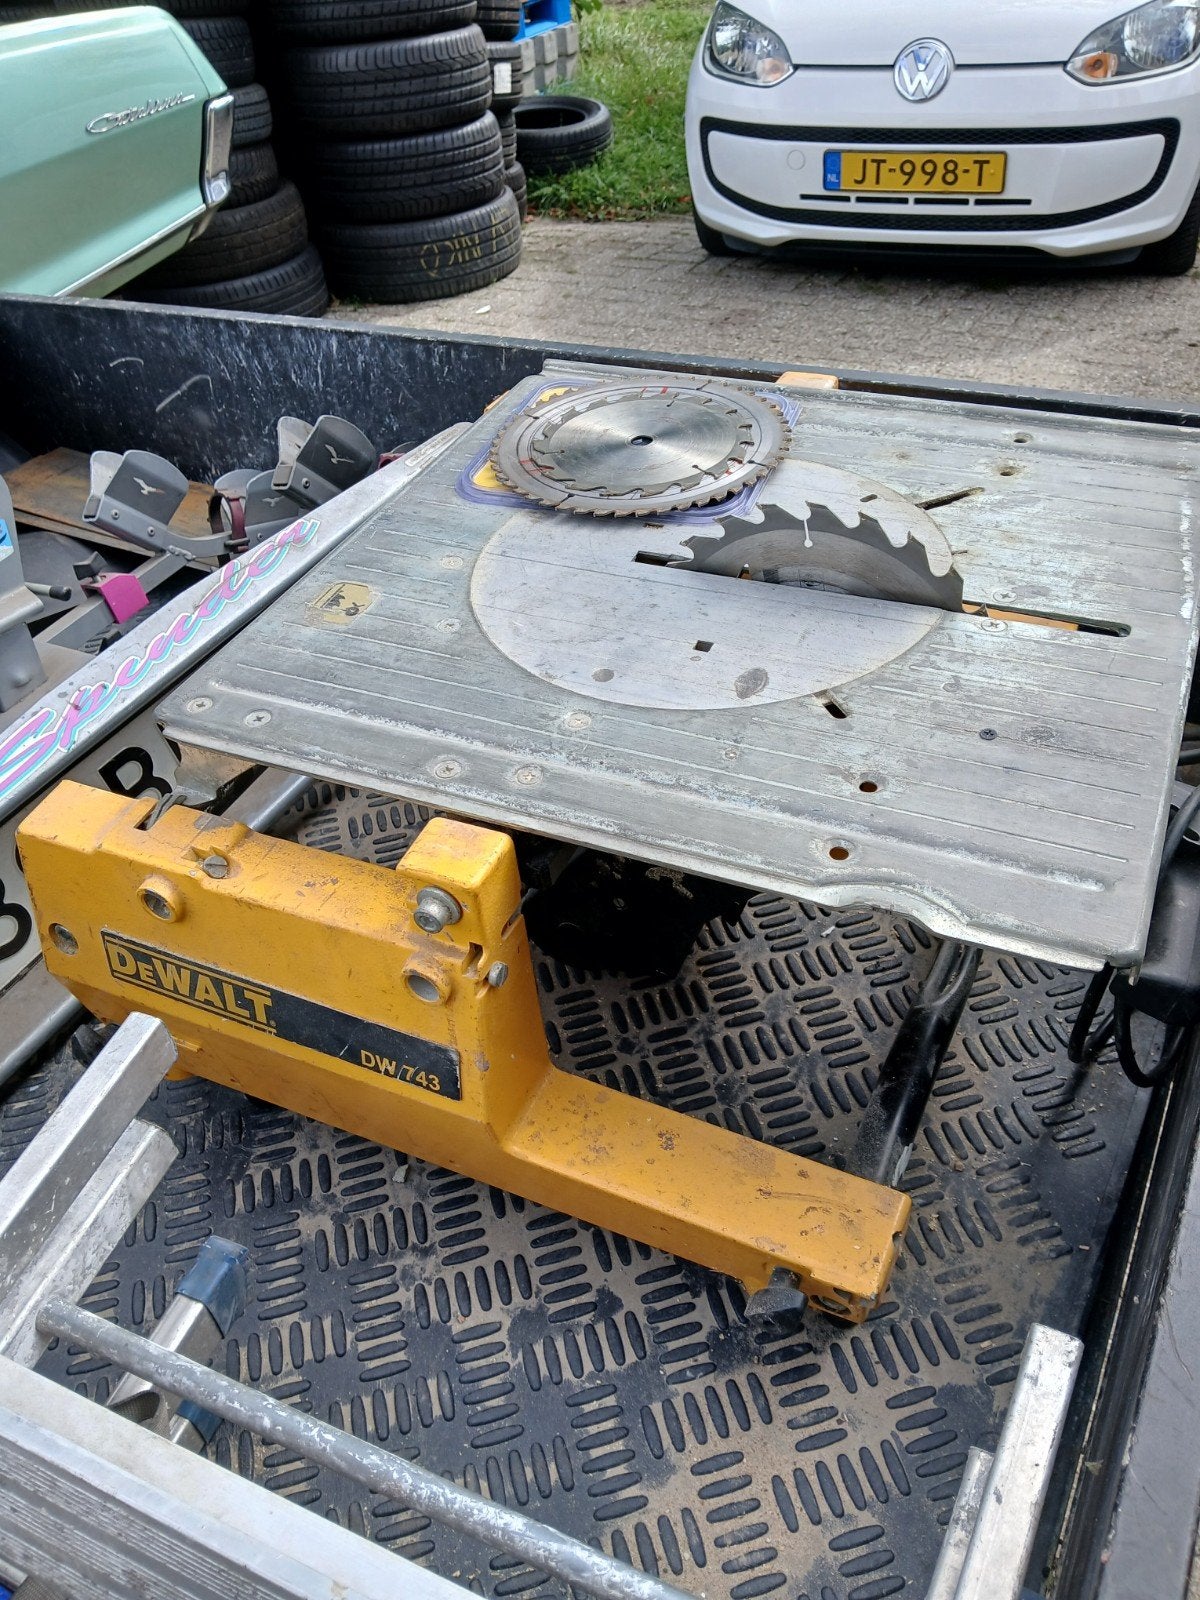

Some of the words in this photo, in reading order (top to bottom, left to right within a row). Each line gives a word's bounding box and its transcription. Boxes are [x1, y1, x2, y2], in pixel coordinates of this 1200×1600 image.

[827, 173, 839, 183] NL
[853, 158, 991, 187] JT-998-T
[402, 1064, 441, 1092] 743
